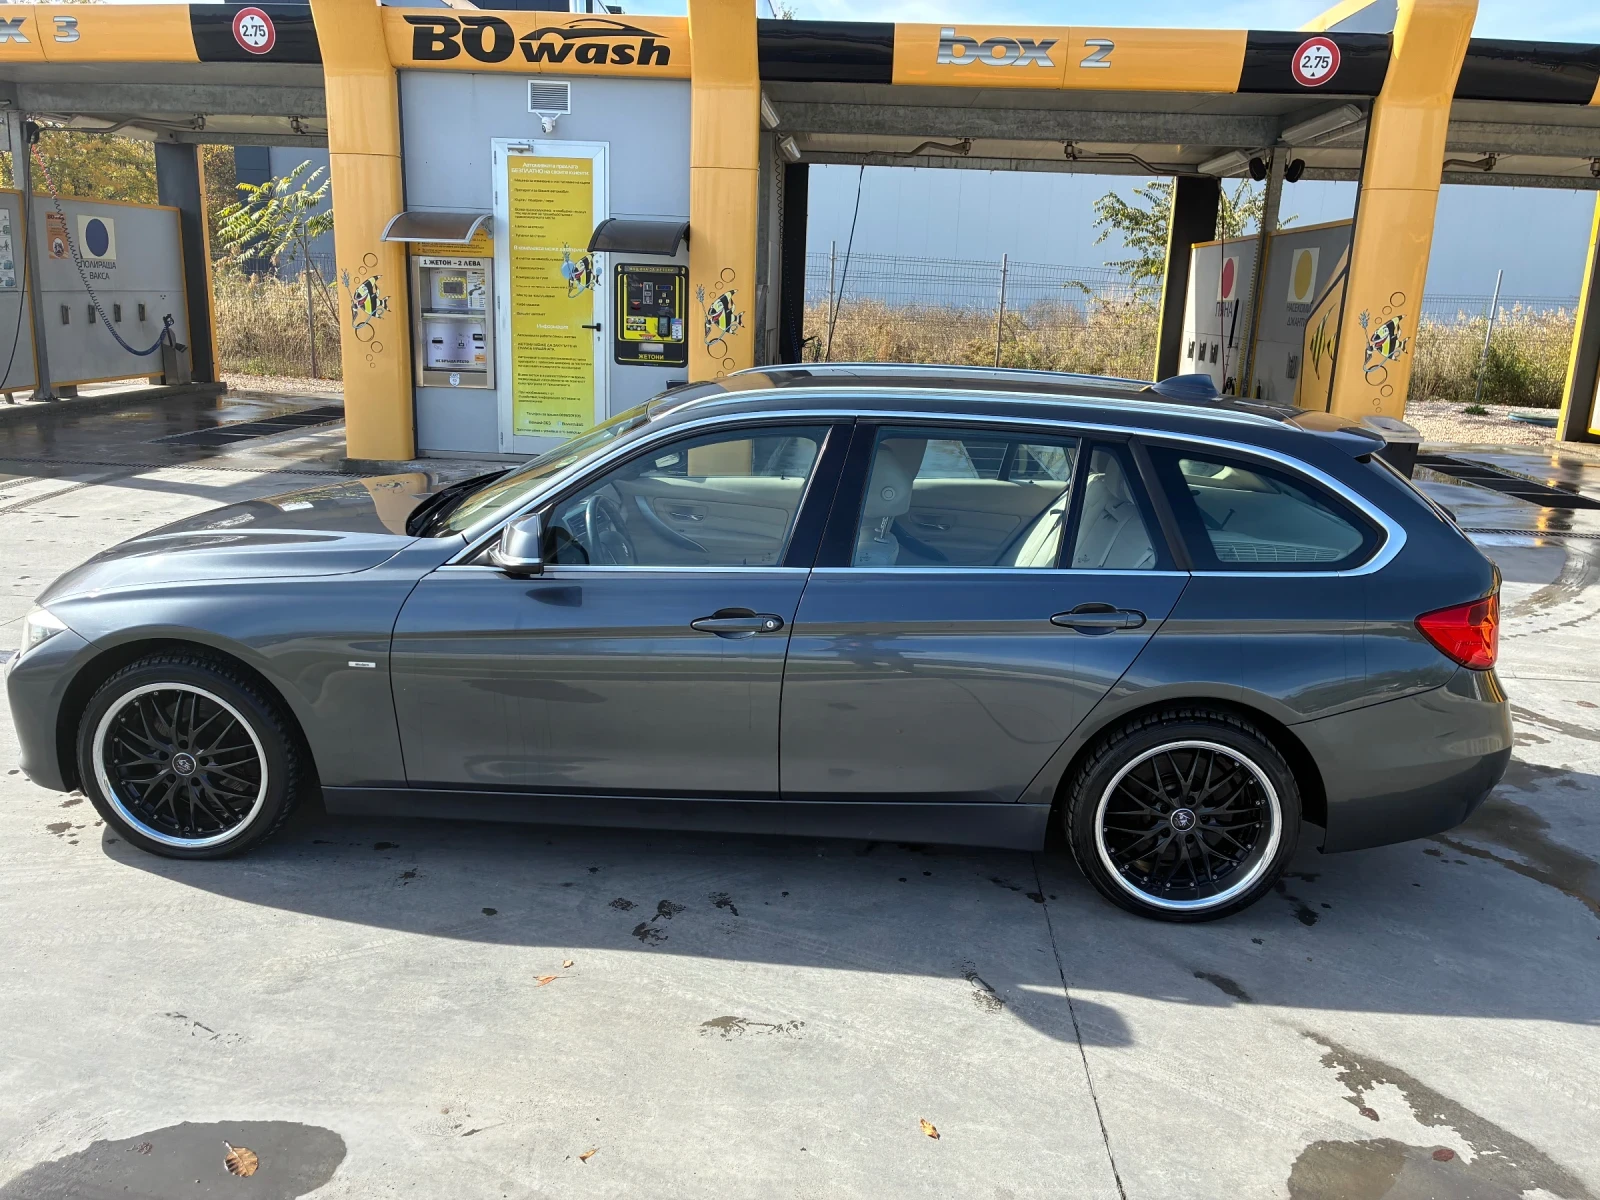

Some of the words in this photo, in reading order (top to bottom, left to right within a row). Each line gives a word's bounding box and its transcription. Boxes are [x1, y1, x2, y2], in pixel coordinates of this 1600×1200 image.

[53, 15, 80, 43] 3
[241, 24, 266, 38] 2.75
[936, 26, 1058, 67] box
[1079, 38, 1115, 68] 2
[1302, 54, 1329, 70] 2.75
[89, 271, 110, 280] ВАКСА
